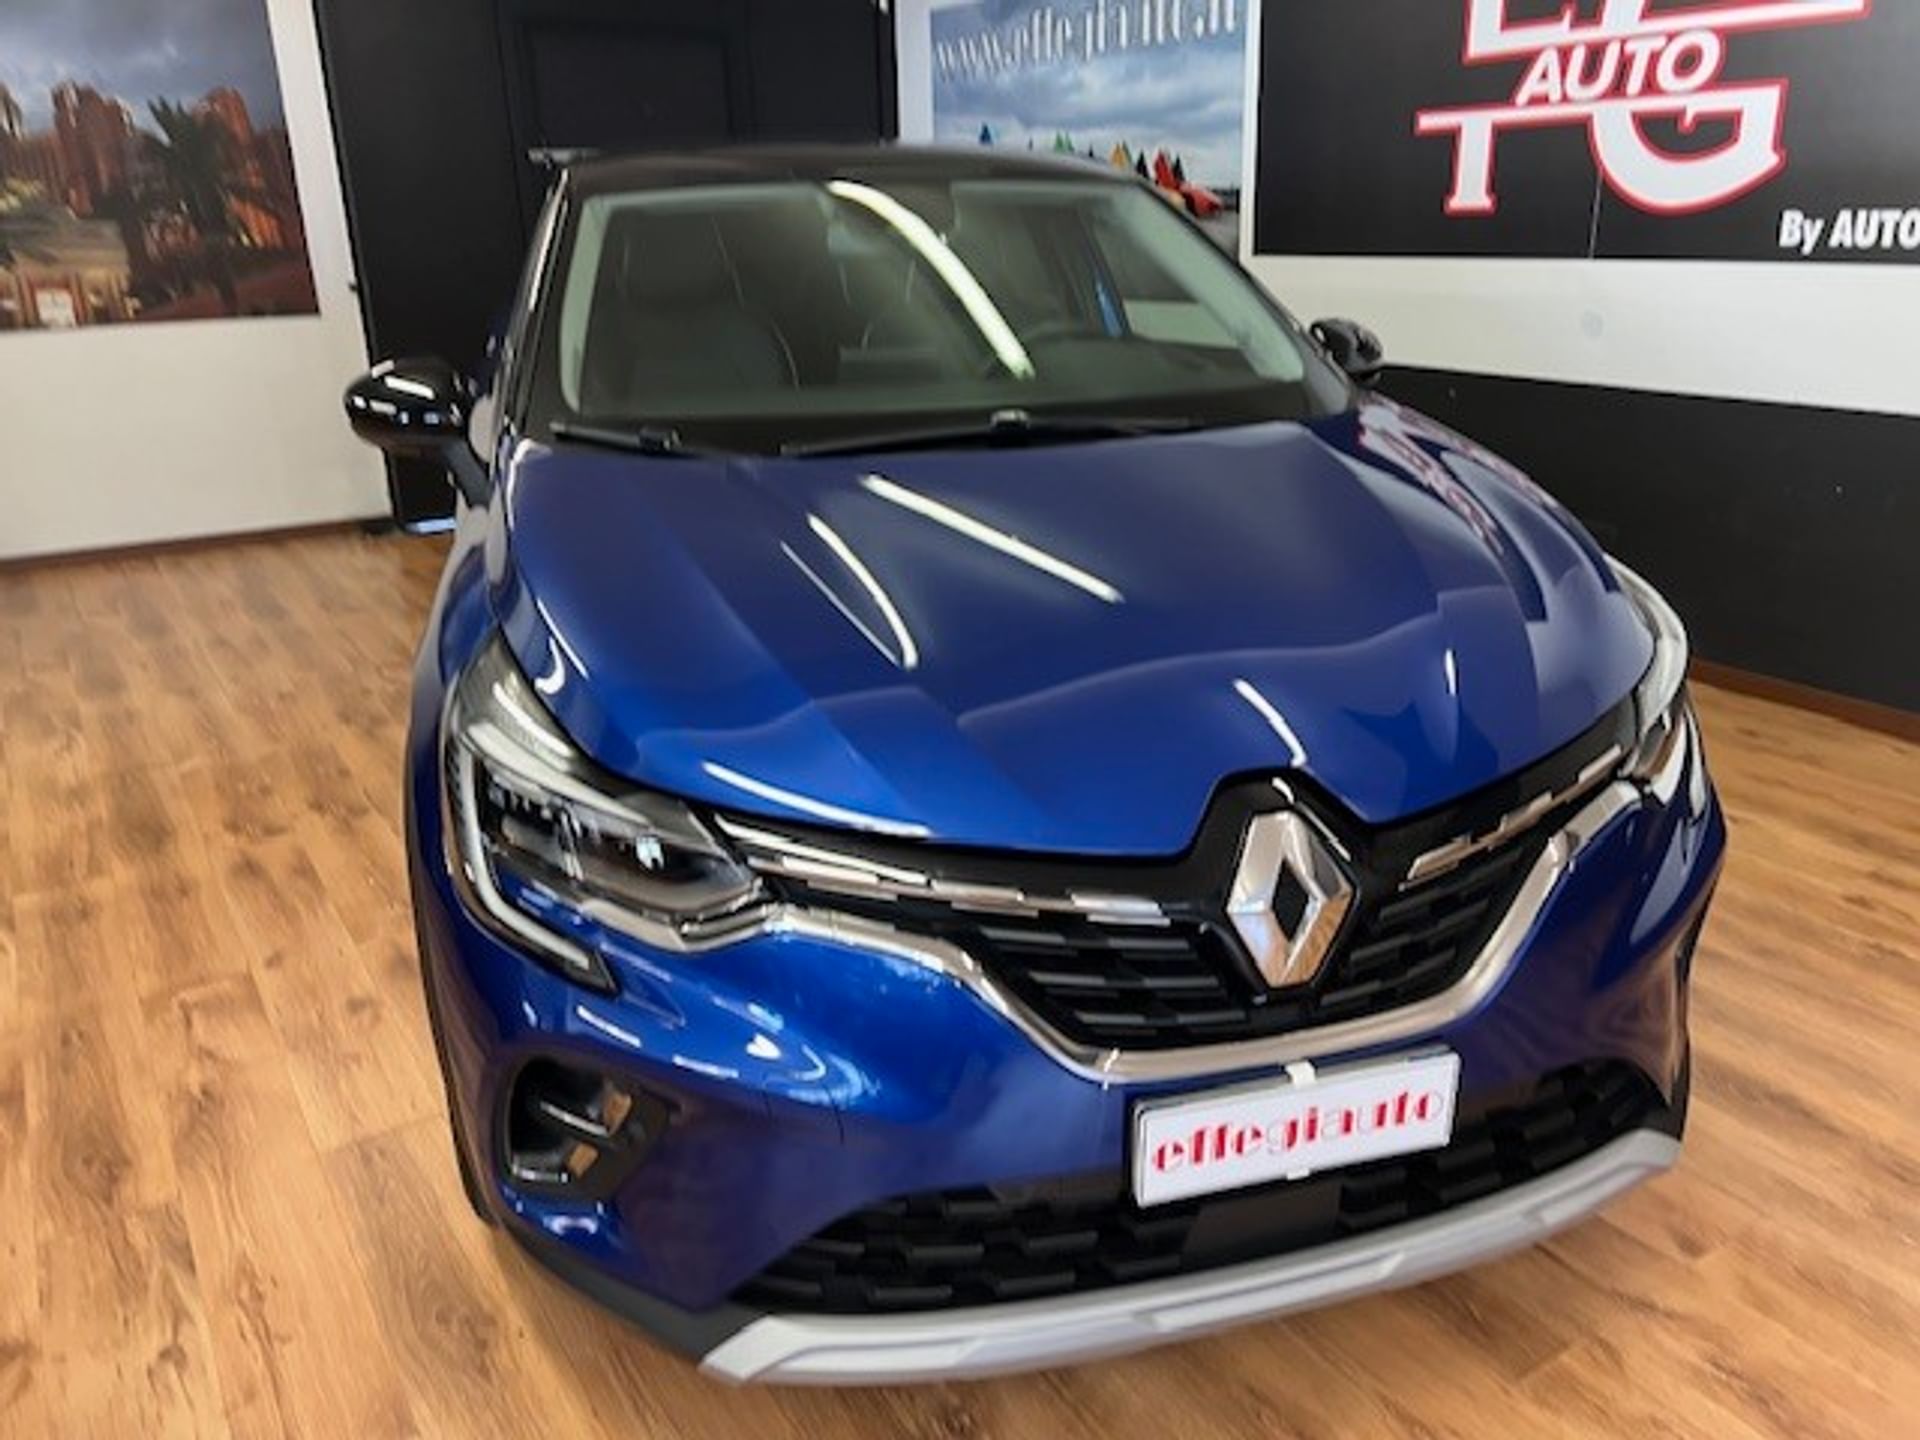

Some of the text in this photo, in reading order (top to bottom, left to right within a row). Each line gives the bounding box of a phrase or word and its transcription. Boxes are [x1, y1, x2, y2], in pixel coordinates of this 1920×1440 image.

[1513, 28, 1723, 106] AUTO
[1778, 207, 1920, 256] By AUTO
[1152, 1090, 1444, 1171] effegiauto
